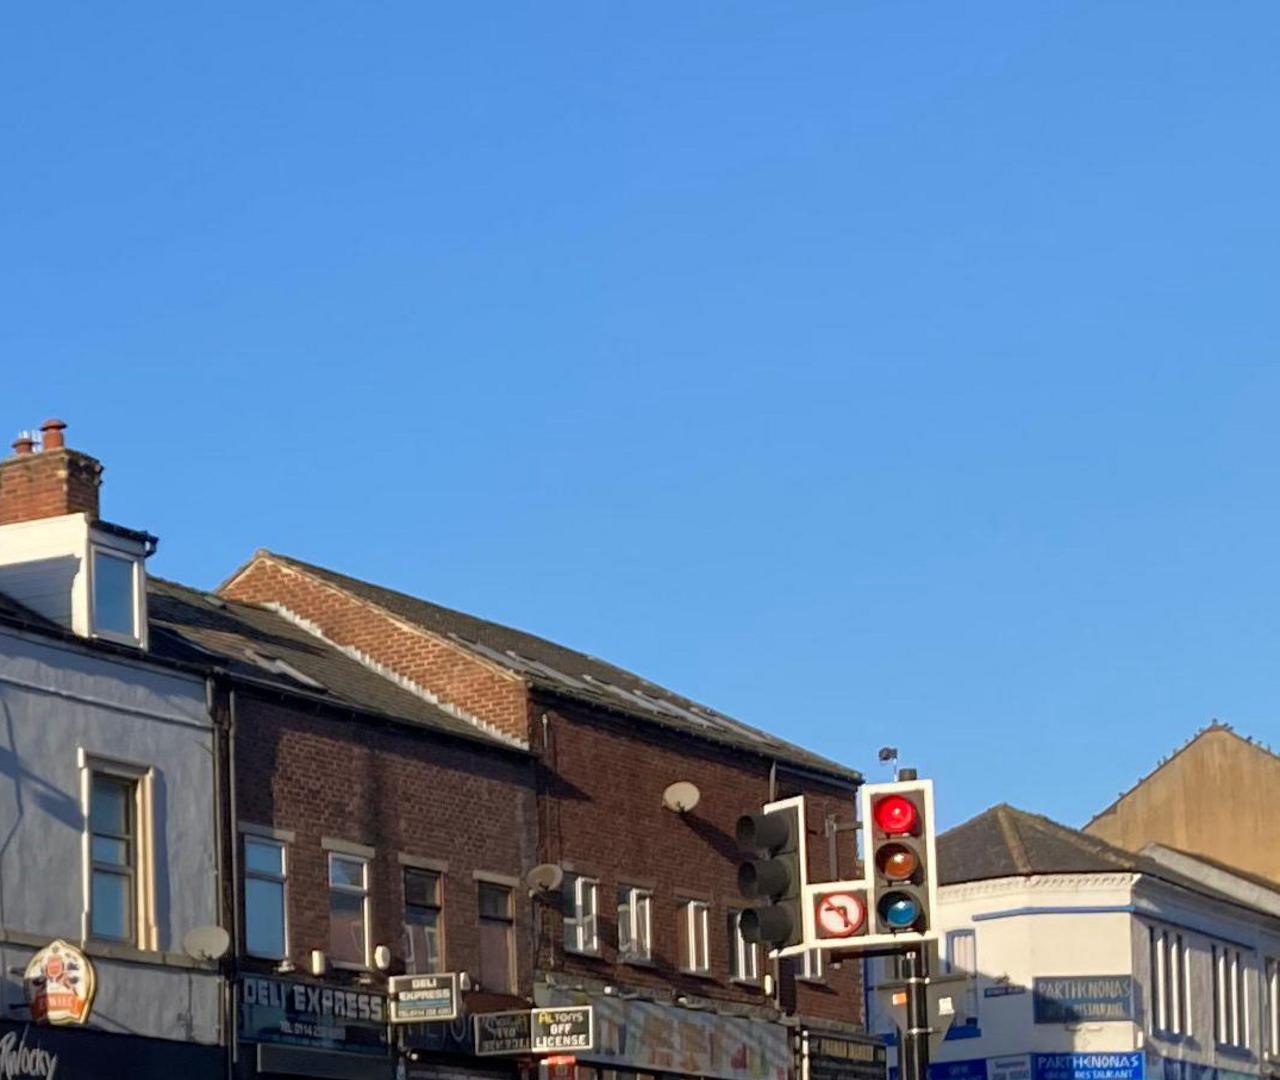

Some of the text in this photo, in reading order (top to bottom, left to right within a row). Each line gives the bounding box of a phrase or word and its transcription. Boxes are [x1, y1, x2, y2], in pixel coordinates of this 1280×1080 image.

[412, 978, 437, 988] DELI
[243, 976, 383, 1021] DELI EXPRESS
[549, 1022, 572, 1035] OFF
[535, 1034, 587, 1048] LICENSE
[1039, 1055, 1140, 1071] PARTHENONAS
